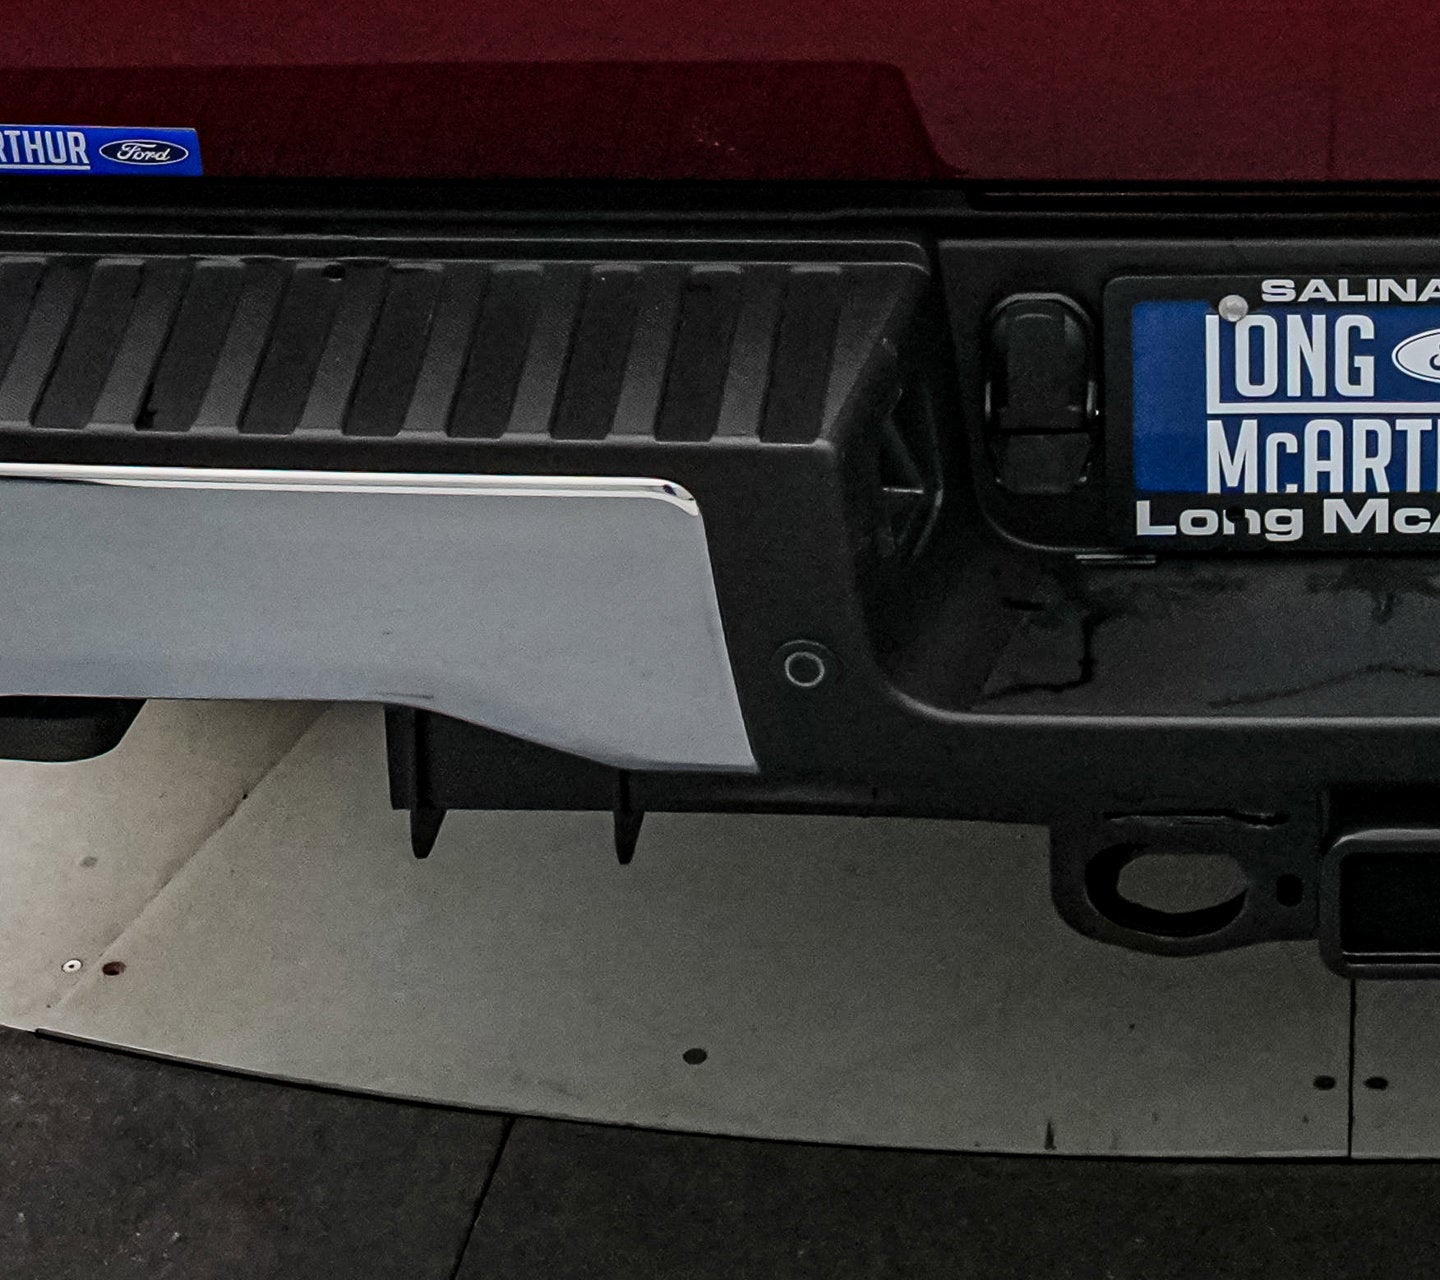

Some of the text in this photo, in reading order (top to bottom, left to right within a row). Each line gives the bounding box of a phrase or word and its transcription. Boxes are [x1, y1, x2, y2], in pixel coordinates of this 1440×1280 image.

[115, 141, 172, 164] Ford
[1205, 313, 1376, 407] LONG
[1135, 500, 1304, 542] Long
